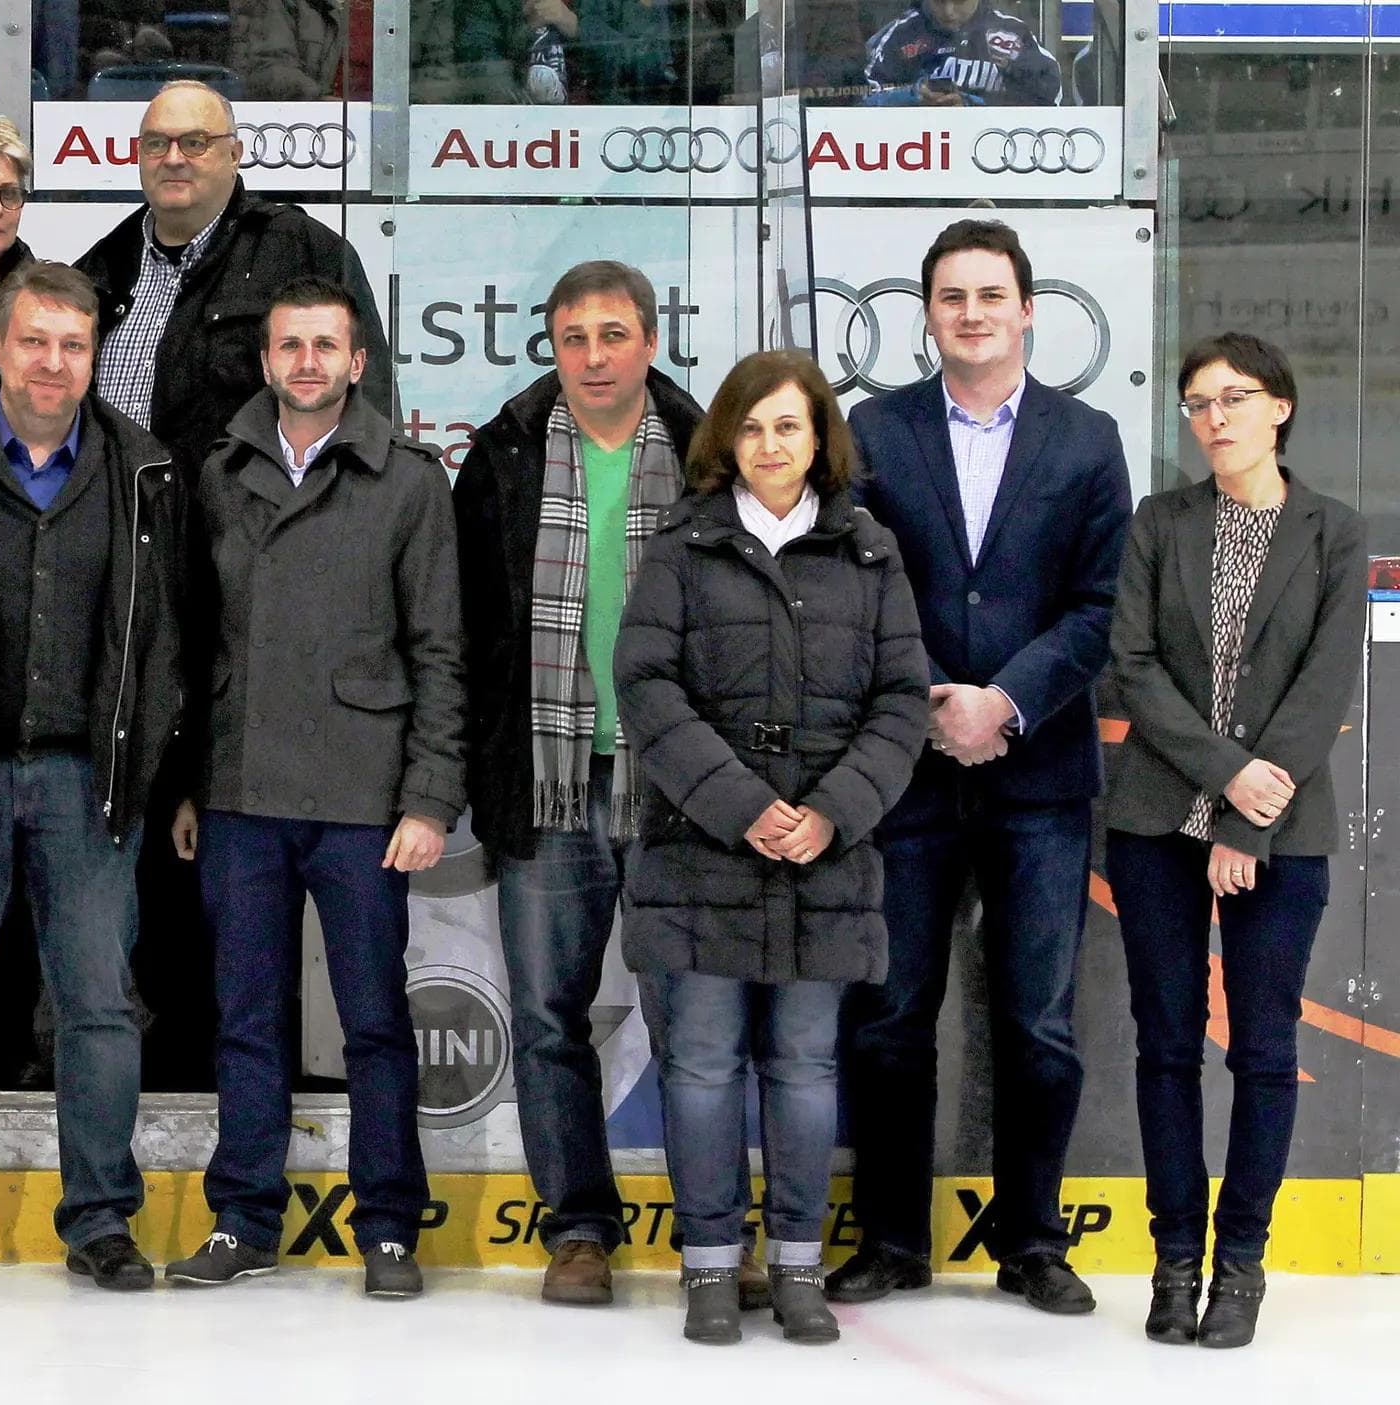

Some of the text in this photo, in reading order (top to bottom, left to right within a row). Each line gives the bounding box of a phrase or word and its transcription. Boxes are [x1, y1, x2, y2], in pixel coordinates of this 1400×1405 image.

[53, 125, 140, 165] Au
[431, 129, 580, 169] Audi
[807, 131, 951, 172] Audi
